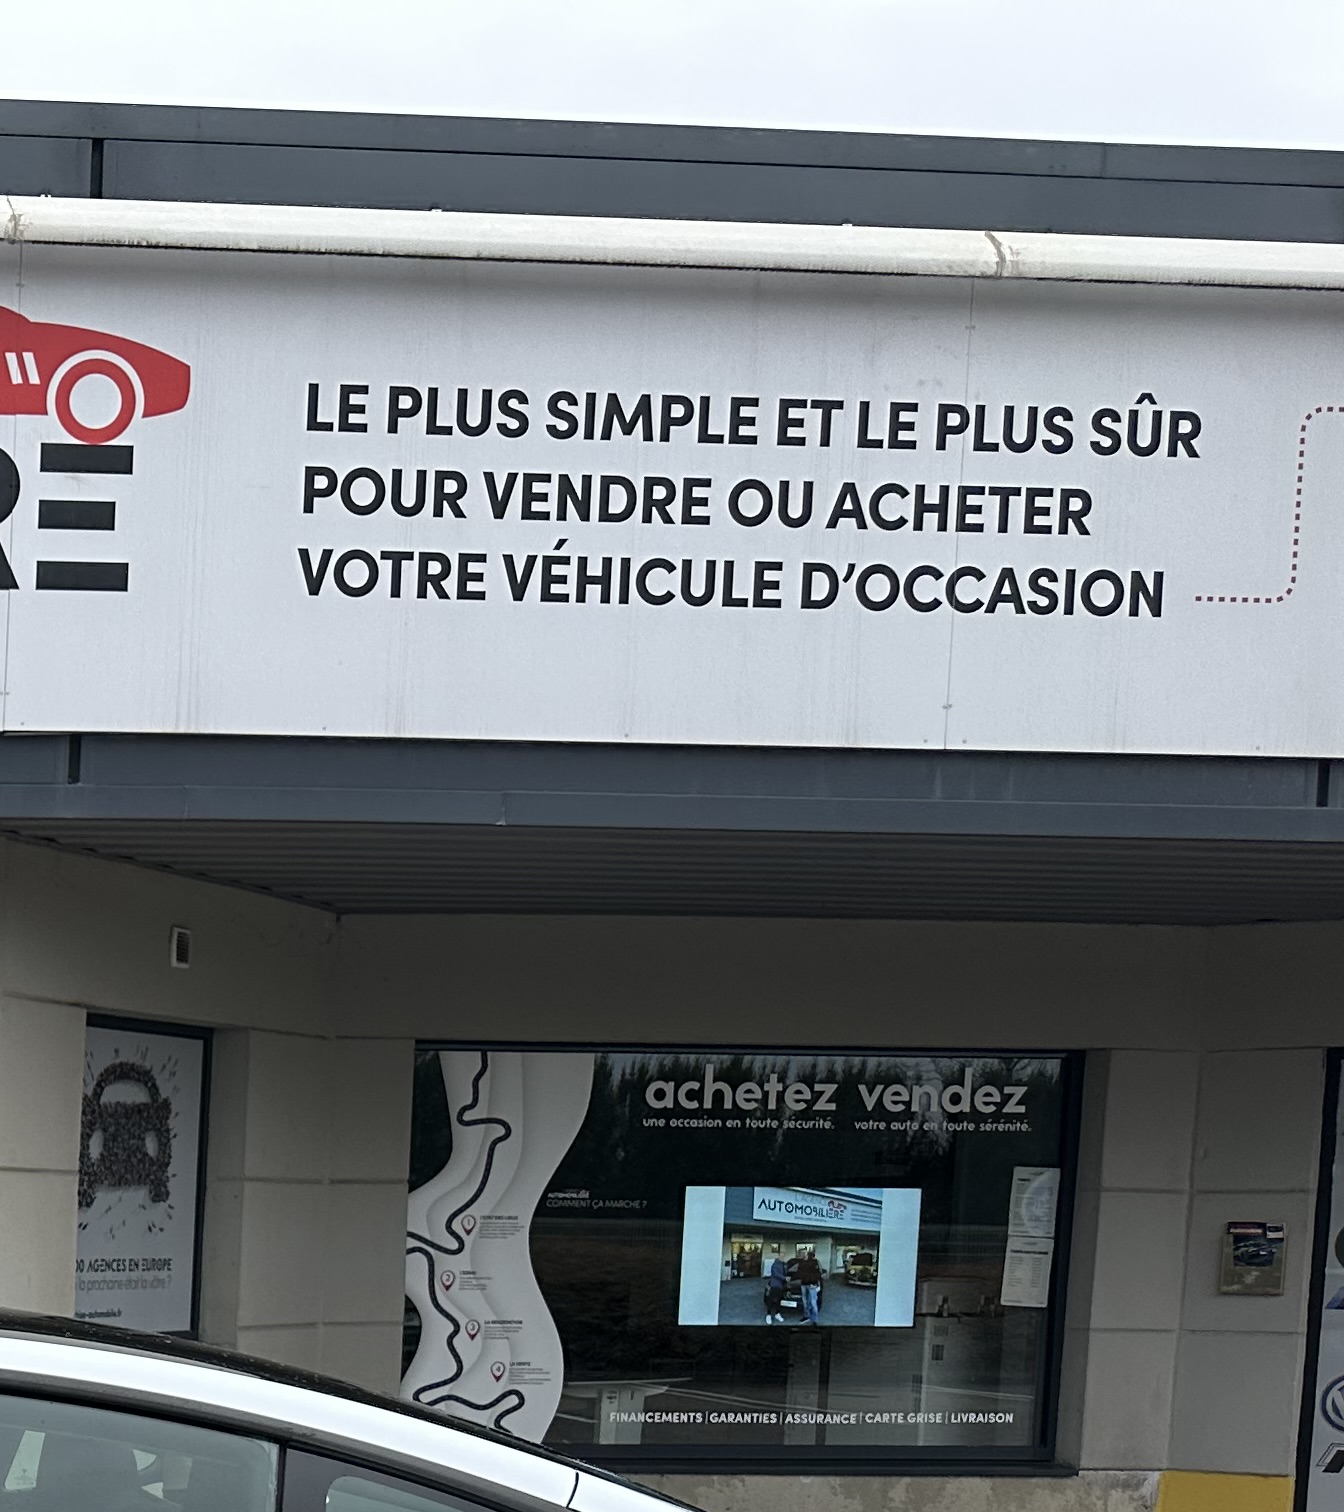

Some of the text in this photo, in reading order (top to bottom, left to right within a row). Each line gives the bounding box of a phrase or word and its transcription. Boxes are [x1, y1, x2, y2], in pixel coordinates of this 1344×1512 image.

[306, 382, 1202, 459] LE PLUS SIMPLE ET LE PLUS SÛR
[302, 465, 1093, 536] POUR VENDRE OU ACHETER
[297, 538, 1165, 618] VOTRE VÉHICULE D'OCCASION
[645, 1063, 1028, 1114] achetez vendez
[642, 1118, 666, 1128] une
[669, 1115, 722, 1128] occasion
[725, 1119, 742, 1128] en
[746, 1116, 779, 1129] toute
[854, 1119, 887, 1131] votre
[890, 1119, 919, 1131] auto
[922, 1121, 938, 1131] en
[943, 1120, 976, 1131] toute
[86, 1258, 127, 1273] AGENCES
[609, 1412, 1015, 1424] FINANCEMENTS GARANTIES ASSURANCE CARTE GRISE LIVRAISON
